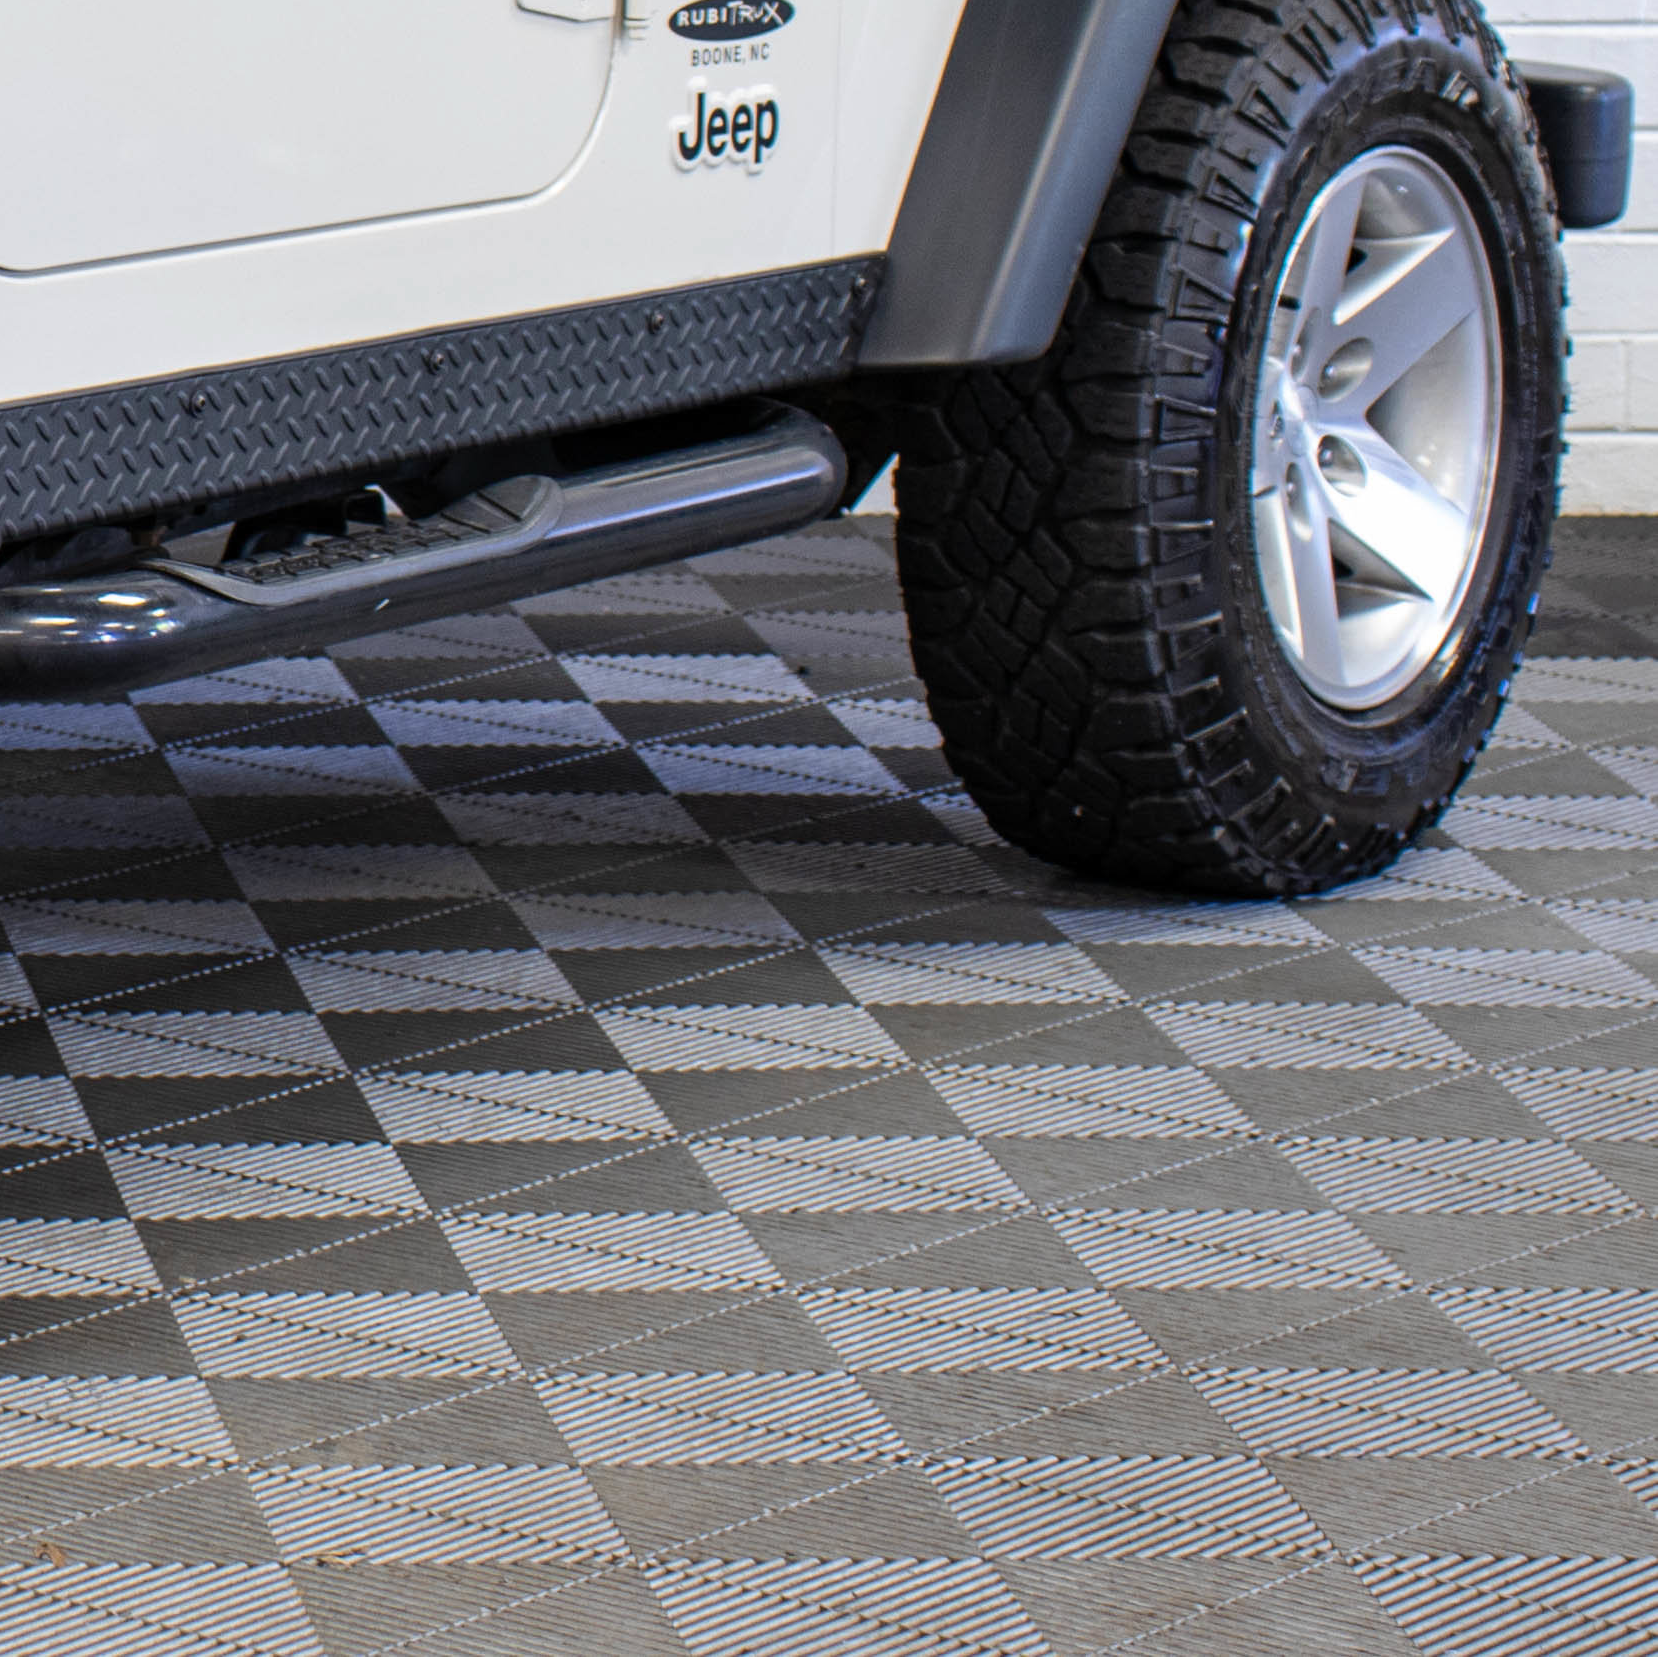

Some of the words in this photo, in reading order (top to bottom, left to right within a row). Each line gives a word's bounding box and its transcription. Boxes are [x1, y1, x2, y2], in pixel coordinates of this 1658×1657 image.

[690, 45, 747, 67] BOONE,
[749, 42, 771, 62] NC
[678, 91, 780, 164] Jeep
